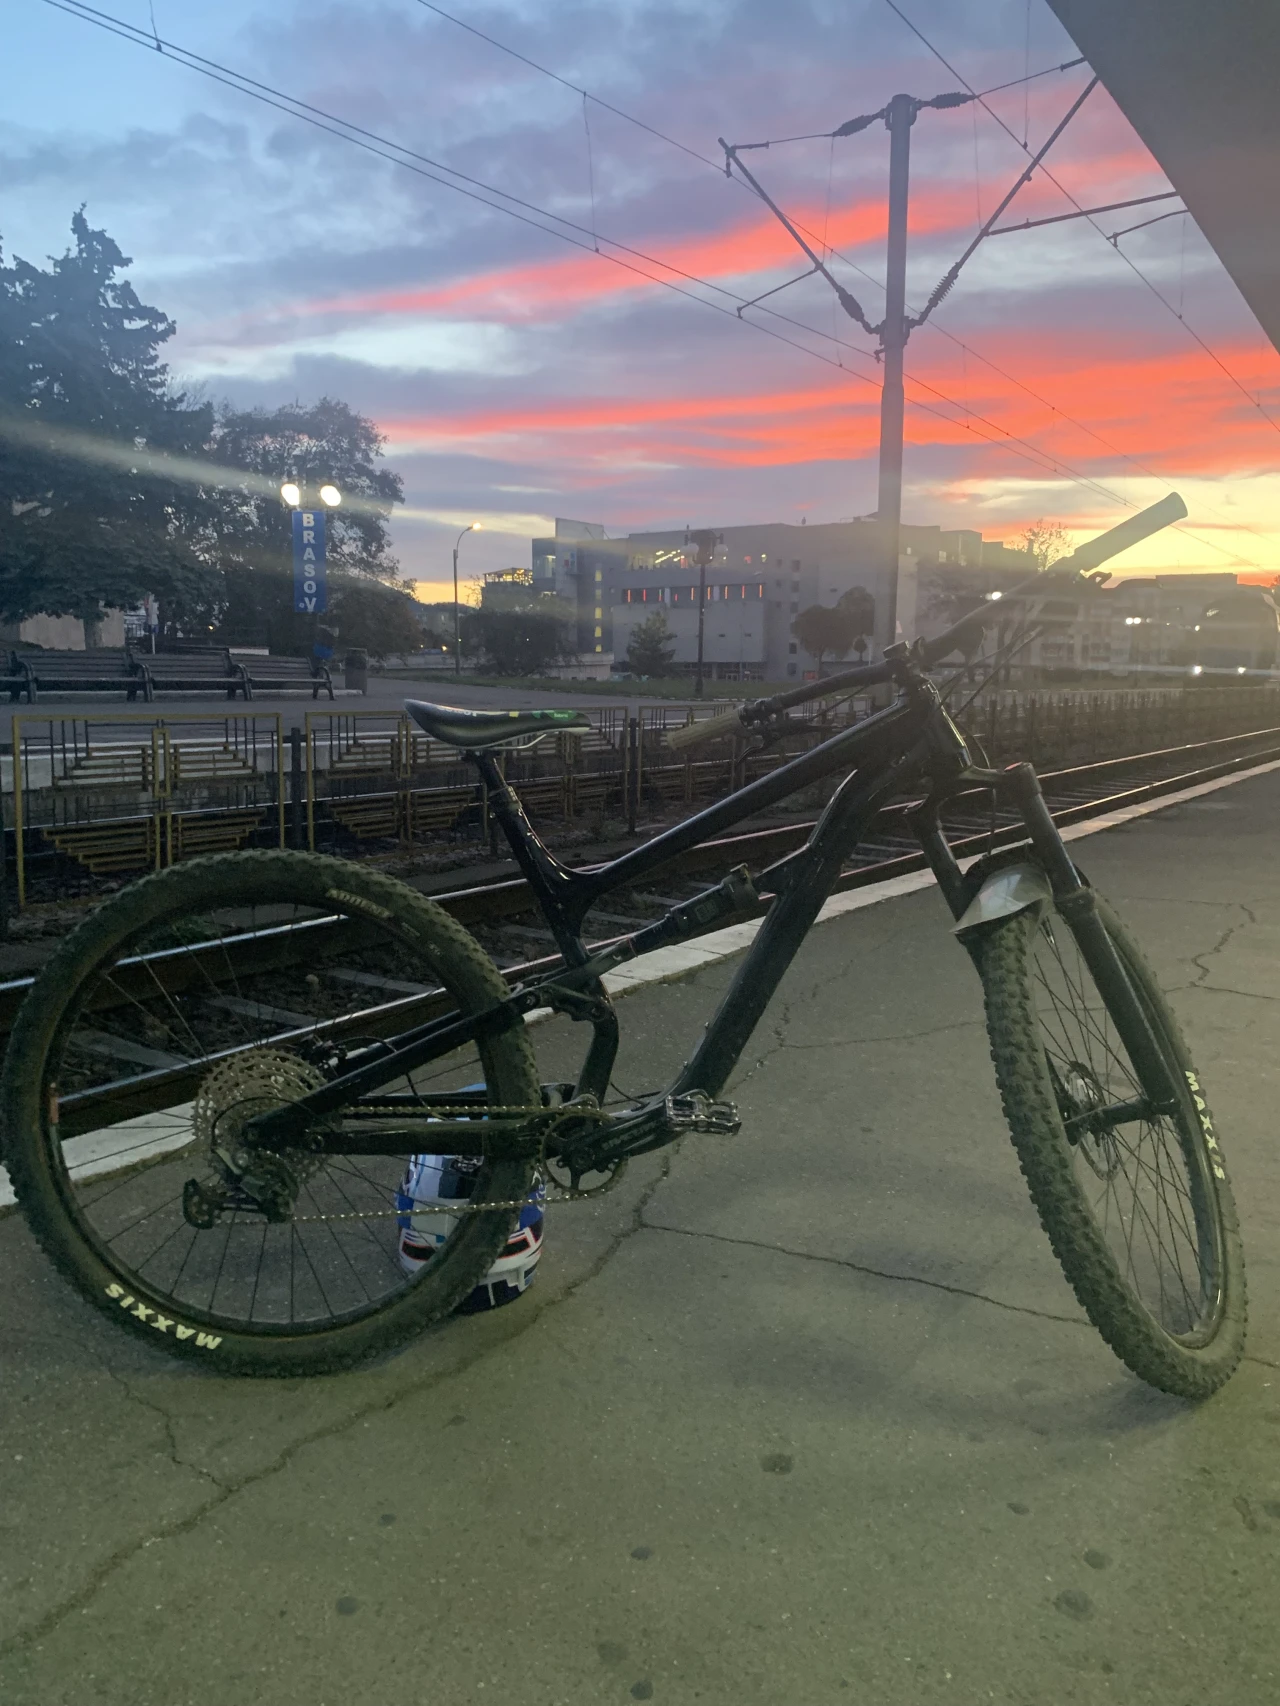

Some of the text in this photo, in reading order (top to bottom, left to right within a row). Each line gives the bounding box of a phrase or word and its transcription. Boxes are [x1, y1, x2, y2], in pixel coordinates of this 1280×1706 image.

[303, 513, 317, 612] BRASOV
[1185, 1070, 1225, 1180] MAXXIS
[105, 1283, 223, 1350] MAXXIS
